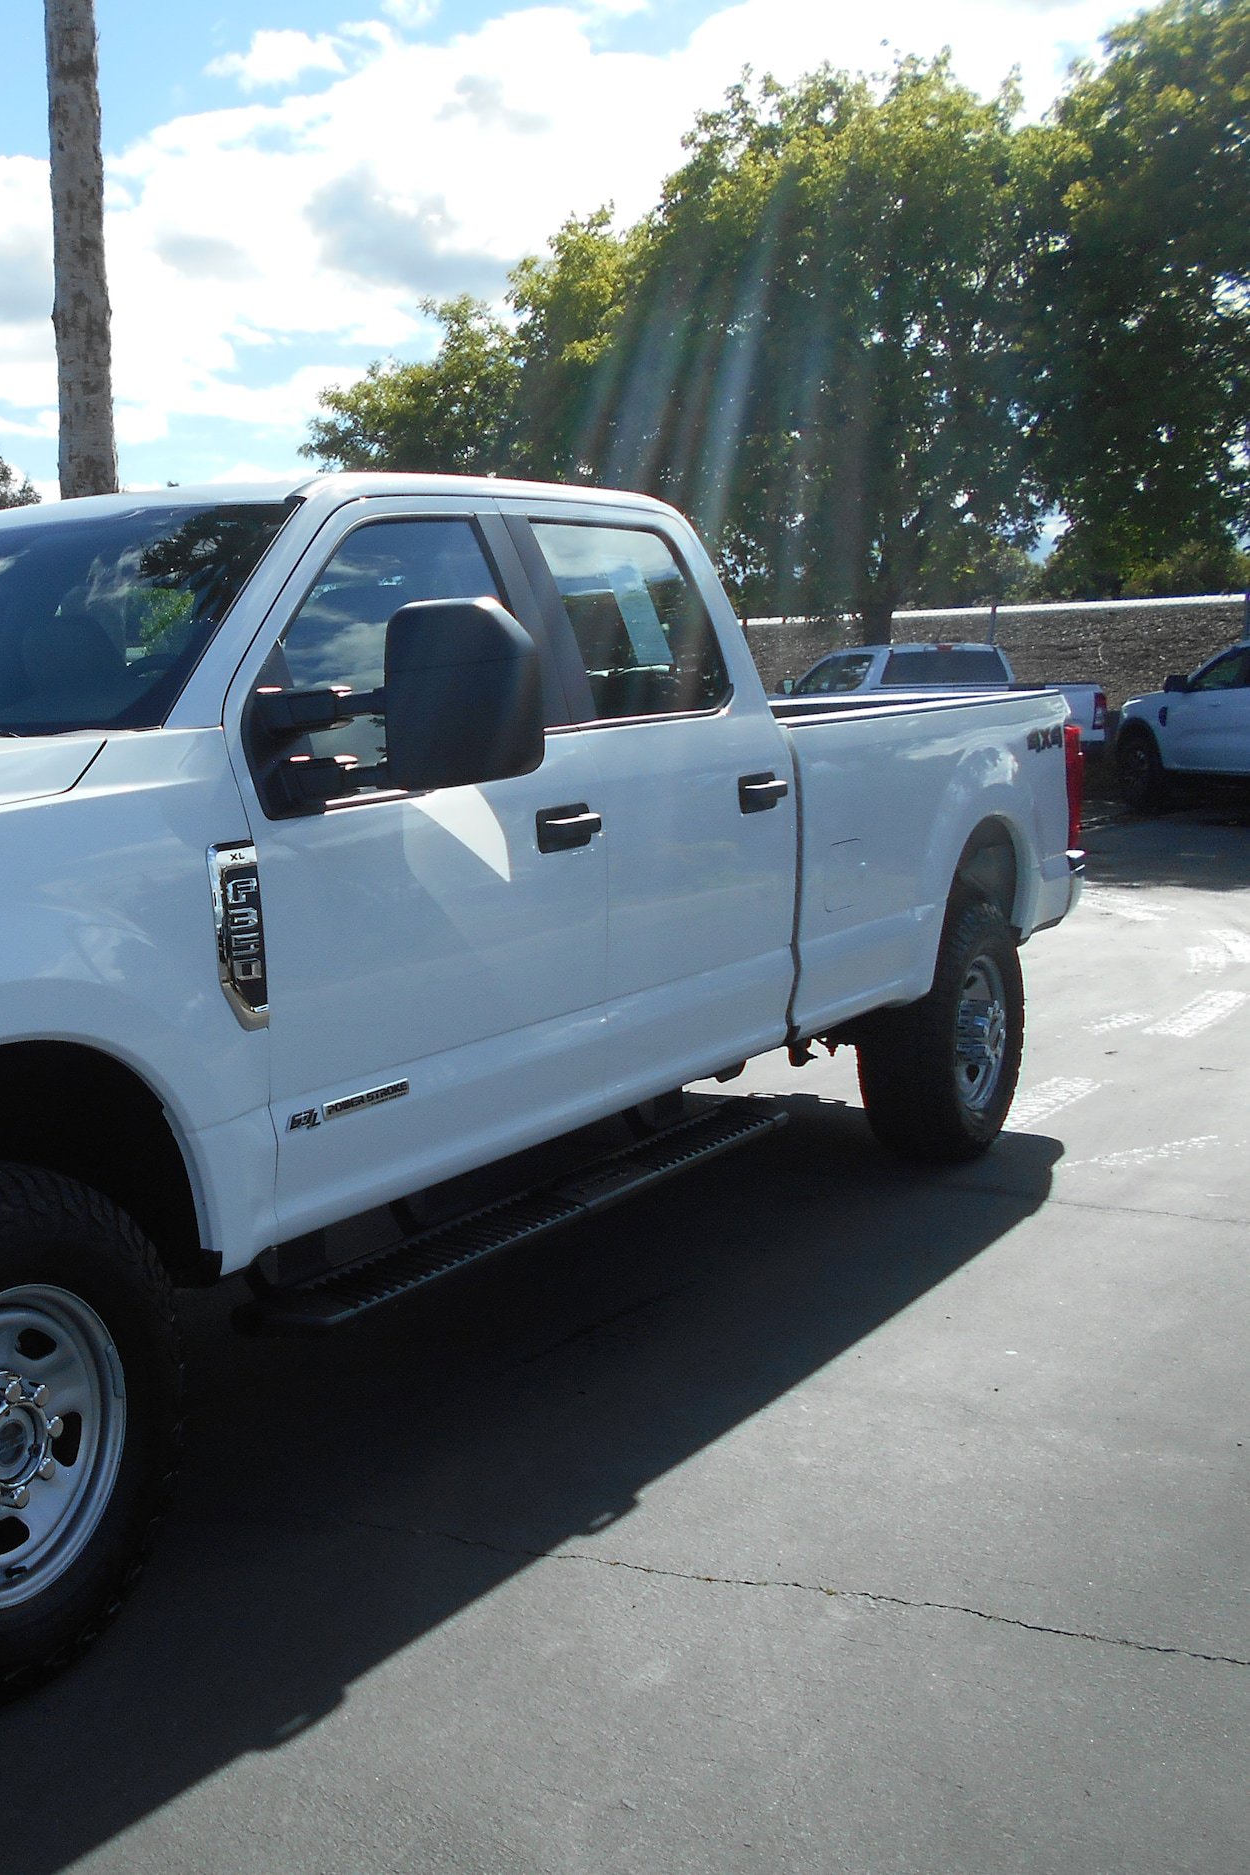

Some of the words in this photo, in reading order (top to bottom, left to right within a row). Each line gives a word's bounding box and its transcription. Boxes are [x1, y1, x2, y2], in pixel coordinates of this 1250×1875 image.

[229, 852, 246, 862] XL
[326, 1095, 365, 1115] POWER
[366, 1081, 408, 1102] STROKE
